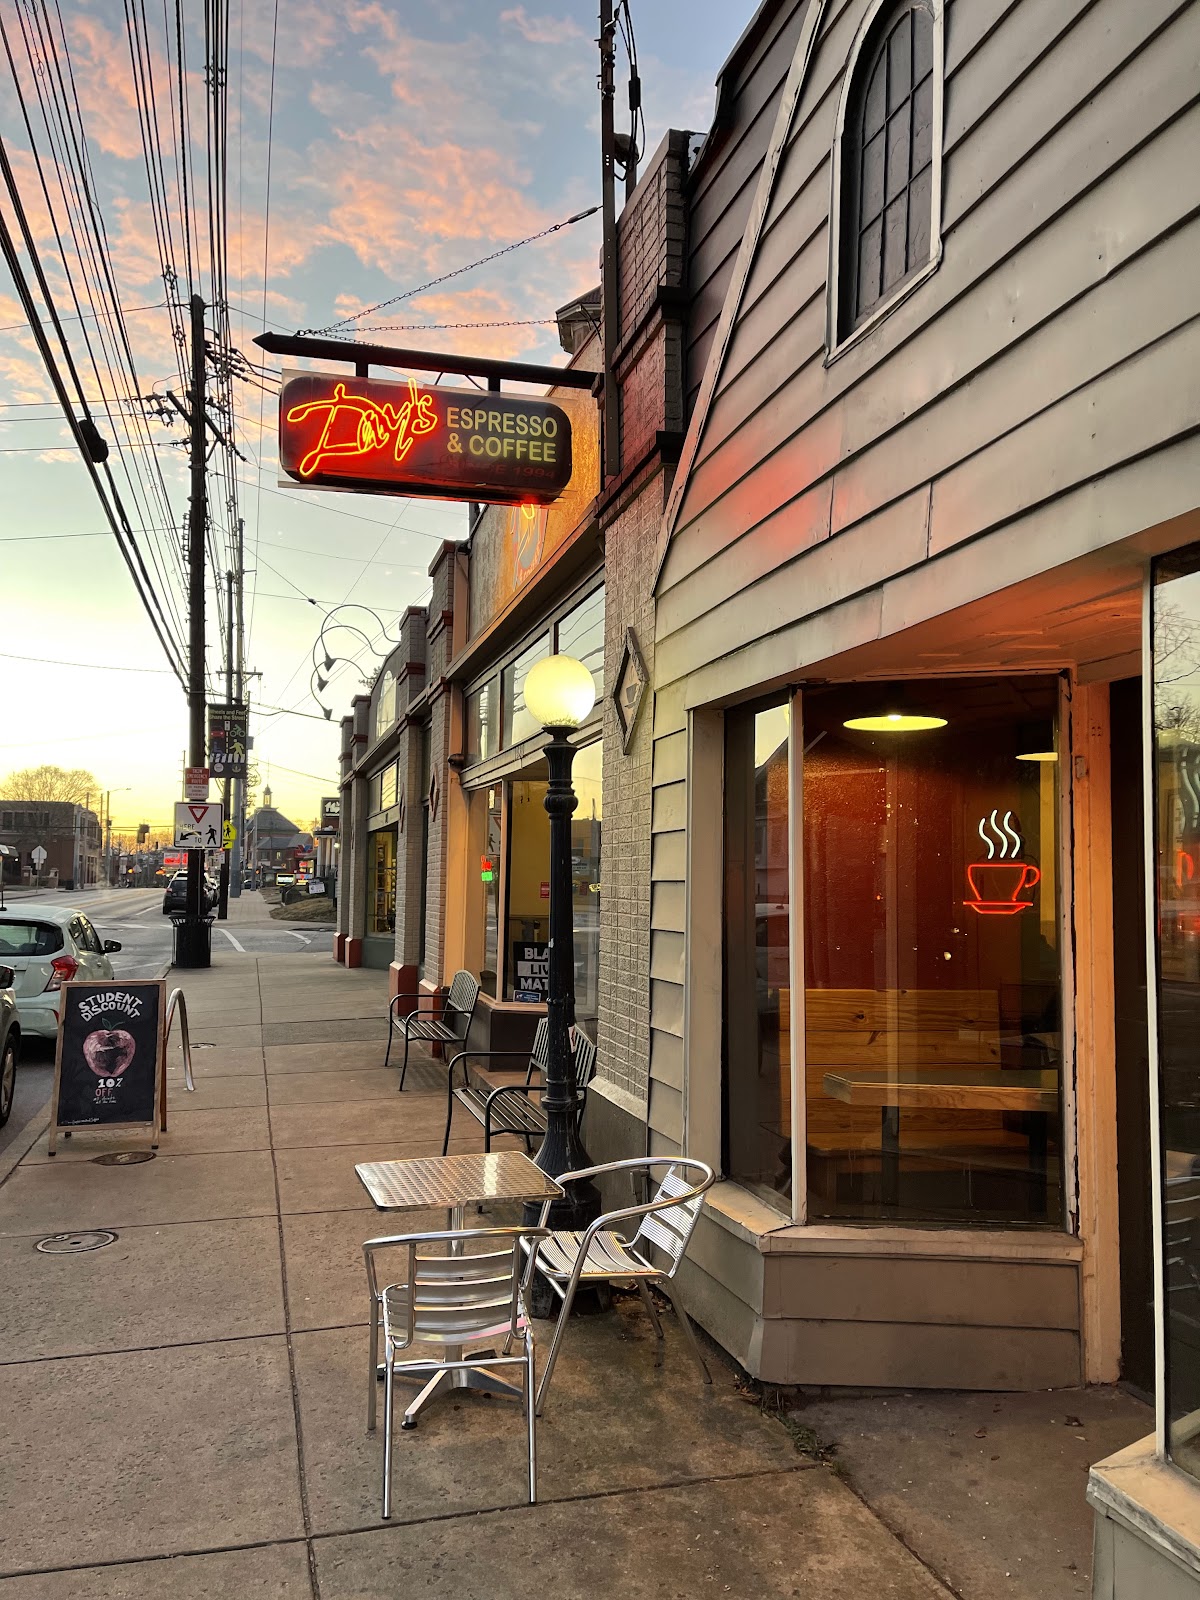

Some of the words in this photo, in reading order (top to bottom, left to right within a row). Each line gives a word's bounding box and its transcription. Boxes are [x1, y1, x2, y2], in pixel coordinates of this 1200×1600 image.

[446, 406, 558, 438] ESPRESSO
[446, 432, 463, 454] &
[469, 434, 557, 463] COFFEE
[524, 948, 549, 960] BLA
[530, 964, 549, 975] LIV
[520, 977, 549, 991] MAT
[78, 992, 143, 1012] STUDENT
[80, 1001, 141, 1022] DISCOUNT
[97, 1078, 123, 1089] 10%
[95, 1088, 114, 1097] OFF
